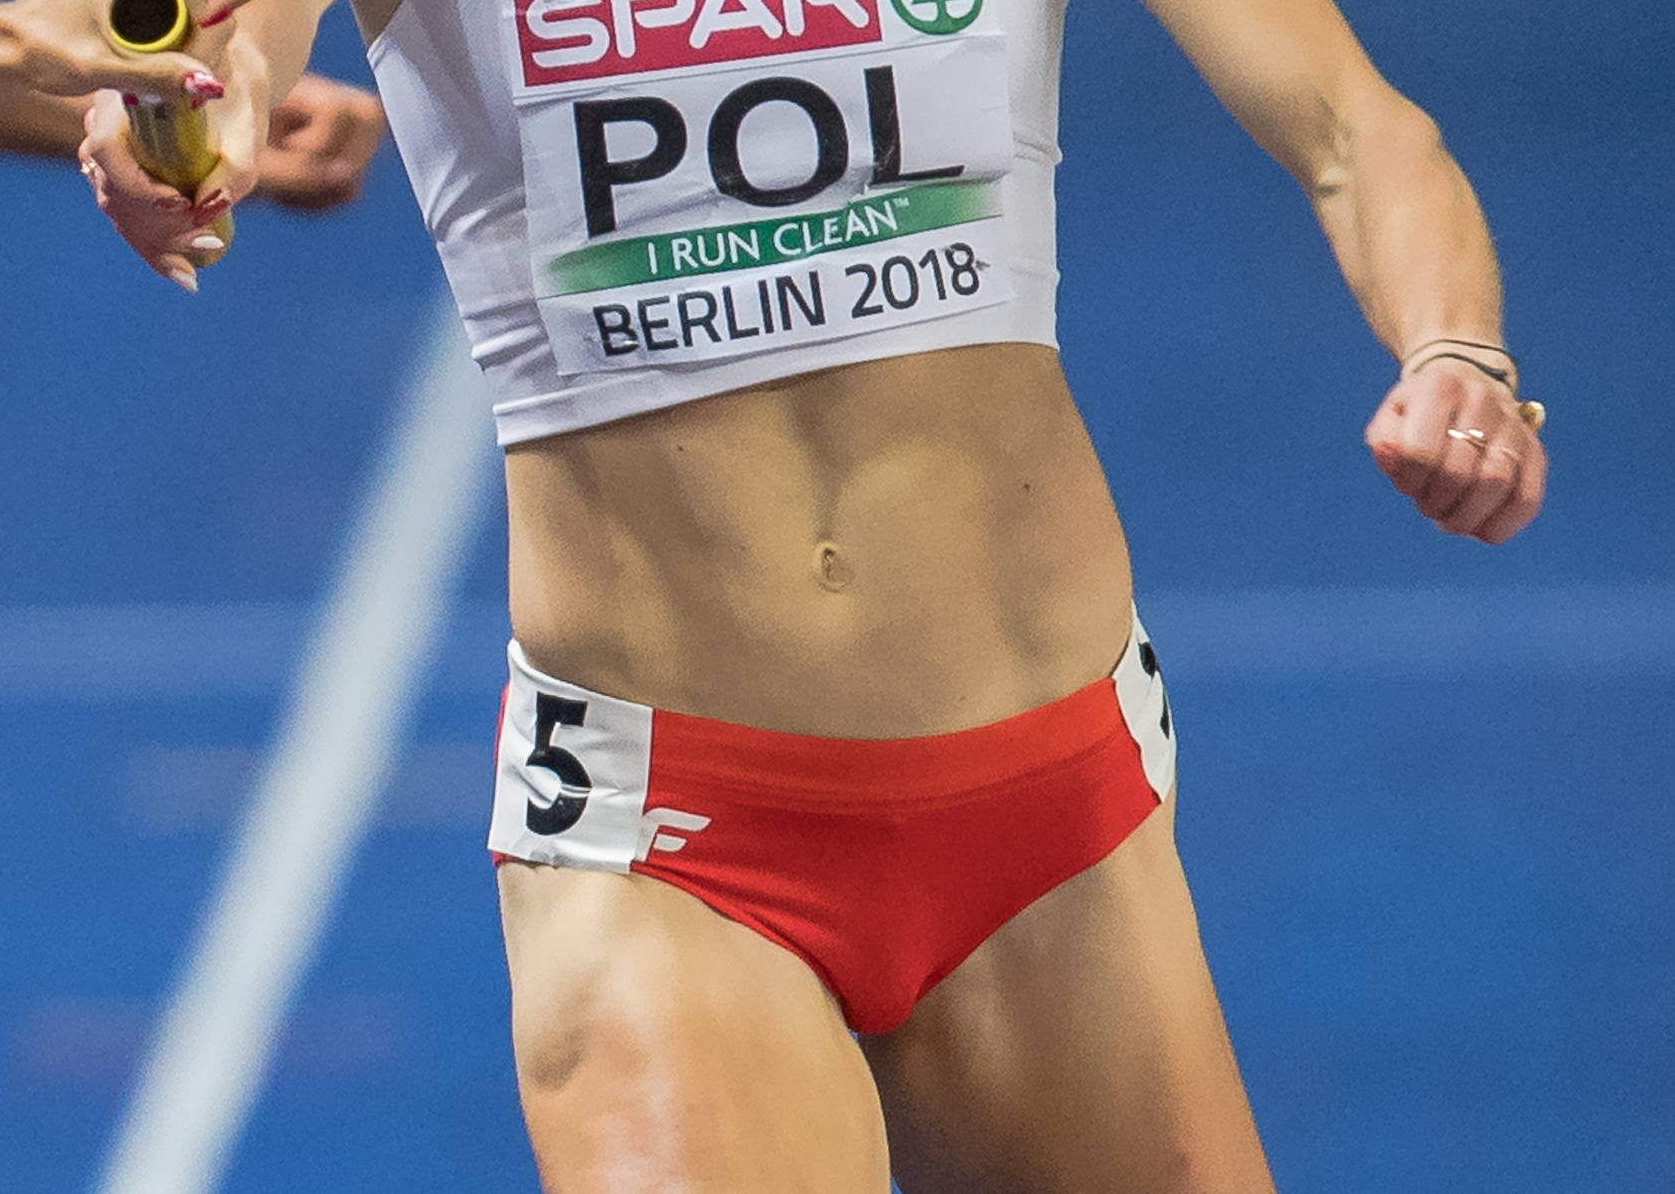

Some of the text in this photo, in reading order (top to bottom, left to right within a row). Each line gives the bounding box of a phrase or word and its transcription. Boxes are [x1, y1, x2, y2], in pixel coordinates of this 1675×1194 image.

[572, 65, 965, 239] POL
[593, 242, 981, 357] BERLIN 2018
[647, 242, 658, 274] I
[672, 229, 761, 270] RUN
[525, 691, 592, 835] 5
